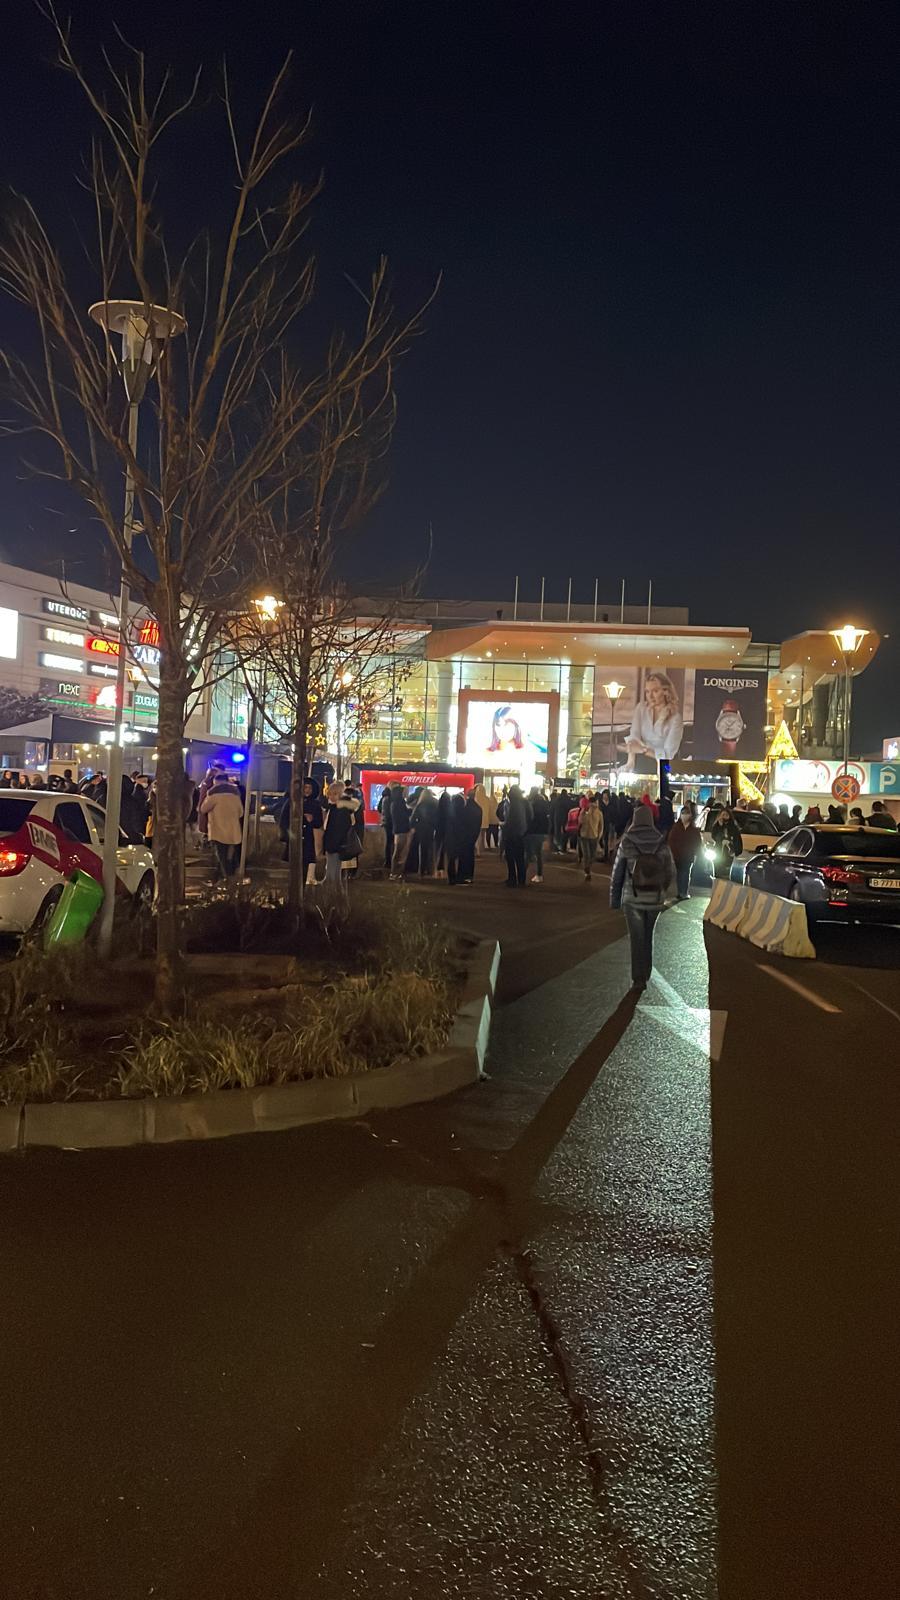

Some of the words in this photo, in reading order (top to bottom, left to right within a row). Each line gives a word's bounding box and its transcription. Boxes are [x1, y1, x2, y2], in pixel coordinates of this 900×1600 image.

[703, 677, 759, 688] LONGINES
[58, 683, 81, 696] next
[401, 774, 437, 784] CINEPLEXX
[880, 771, 896, 792] P
